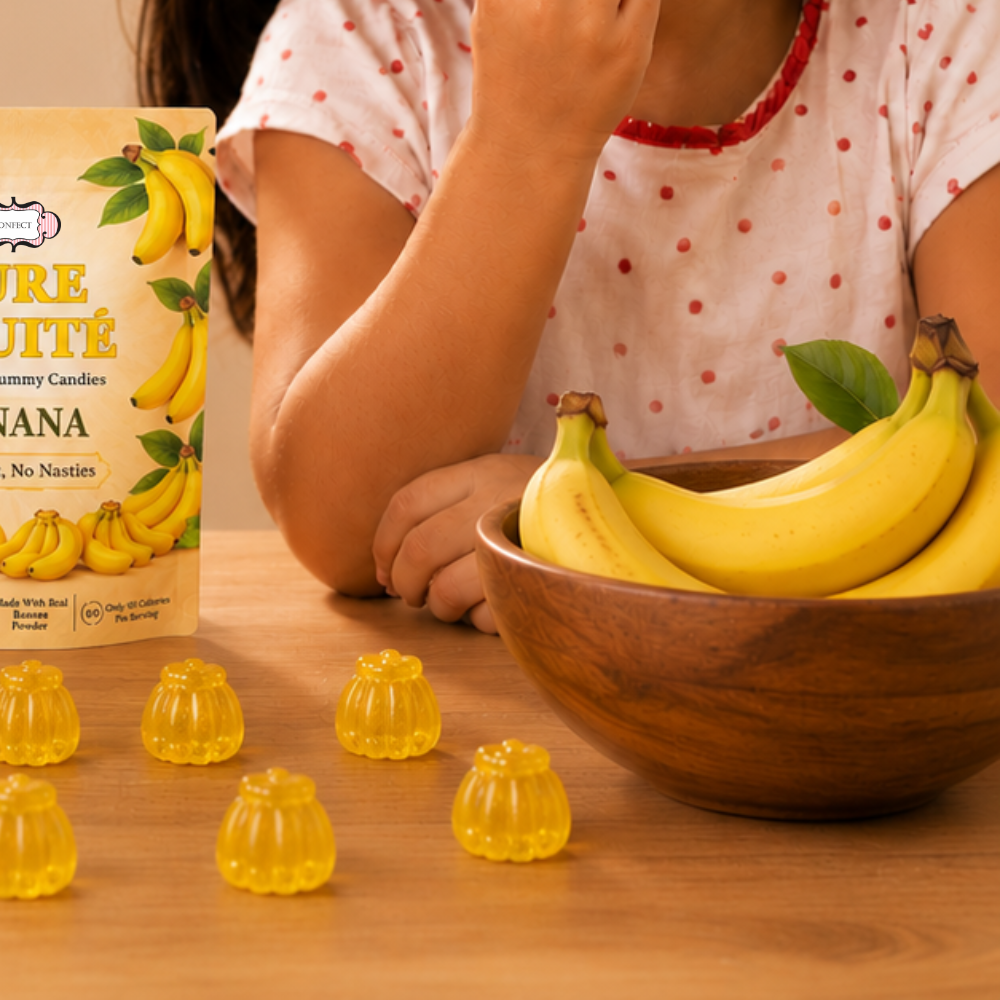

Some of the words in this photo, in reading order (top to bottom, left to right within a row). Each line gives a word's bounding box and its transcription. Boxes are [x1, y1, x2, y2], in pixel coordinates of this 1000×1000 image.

[48, 372, 107, 387] Candies
[11, 463, 35, 478] No
[39, 463, 96, 479] Nasties
